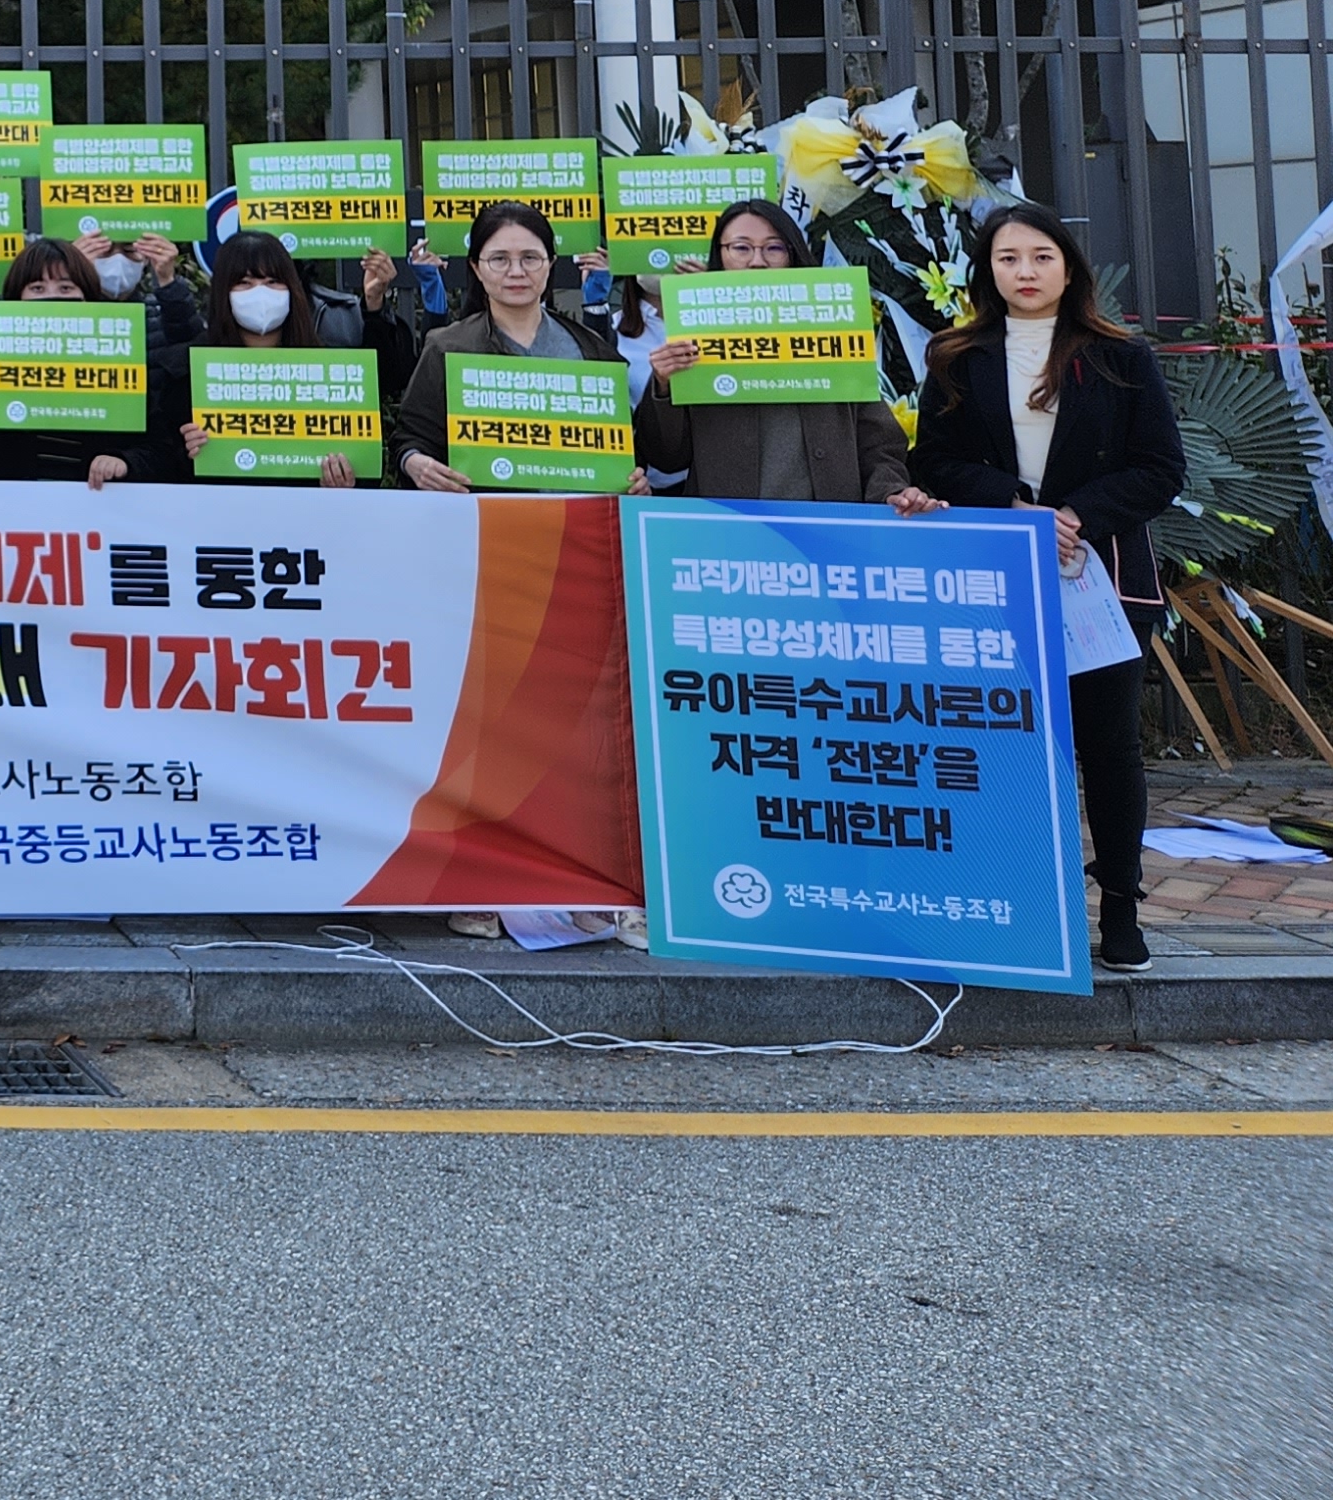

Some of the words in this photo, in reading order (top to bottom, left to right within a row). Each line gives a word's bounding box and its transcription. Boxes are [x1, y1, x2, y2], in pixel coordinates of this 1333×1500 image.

[48, 183, 134, 204] 자격전환
[246, 200, 332, 221] 자격전환
[614, 214, 707, 238] 자격전환
[677, 283, 809, 305] 특별양성체제를
[813, 282, 854, 301] 통한
[679, 306, 774, 326] 장애영유아
[776, 303, 856, 324] 보육교사
[696, 336, 781, 360] 격전환
[206, 363, 324, 381] 특별양성체제를
[328, 364, 364, 381] 통한
[462, 368, 578, 392] 특별양성체제를
[581, 376, 614, 395] 통한
[206, 383, 292, 401] 장애영유아
[294, 384, 365, 402] 보육교사
[462, 389, 547, 411] 장애영유아
[549, 394, 616, 416] 보육교사
[201, 412, 296, 435] 자격전환
[457, 419, 552, 446] 자격전환
[194, 544, 325, 611] 통한
[672, 559, 820, 598] 교직개방의
[827, 564, 858, 600] 또
[866, 565, 927, 604] 다른
[935, 569, 1007, 607] 이름!
[672, 614, 928, 665] 특별양성체제를
[939, 629, 1016, 669] 통한
[70, 631, 414, 723] 기자회견
[662, 669, 1035, 733] 유아특수교사로의
[711, 733, 800, 779] 자격
[813, 737, 981, 791] '전환'을
[756, 796, 952, 851] 반대한다!
[784, 883, 1013, 925] 전국특수교사노동조합
